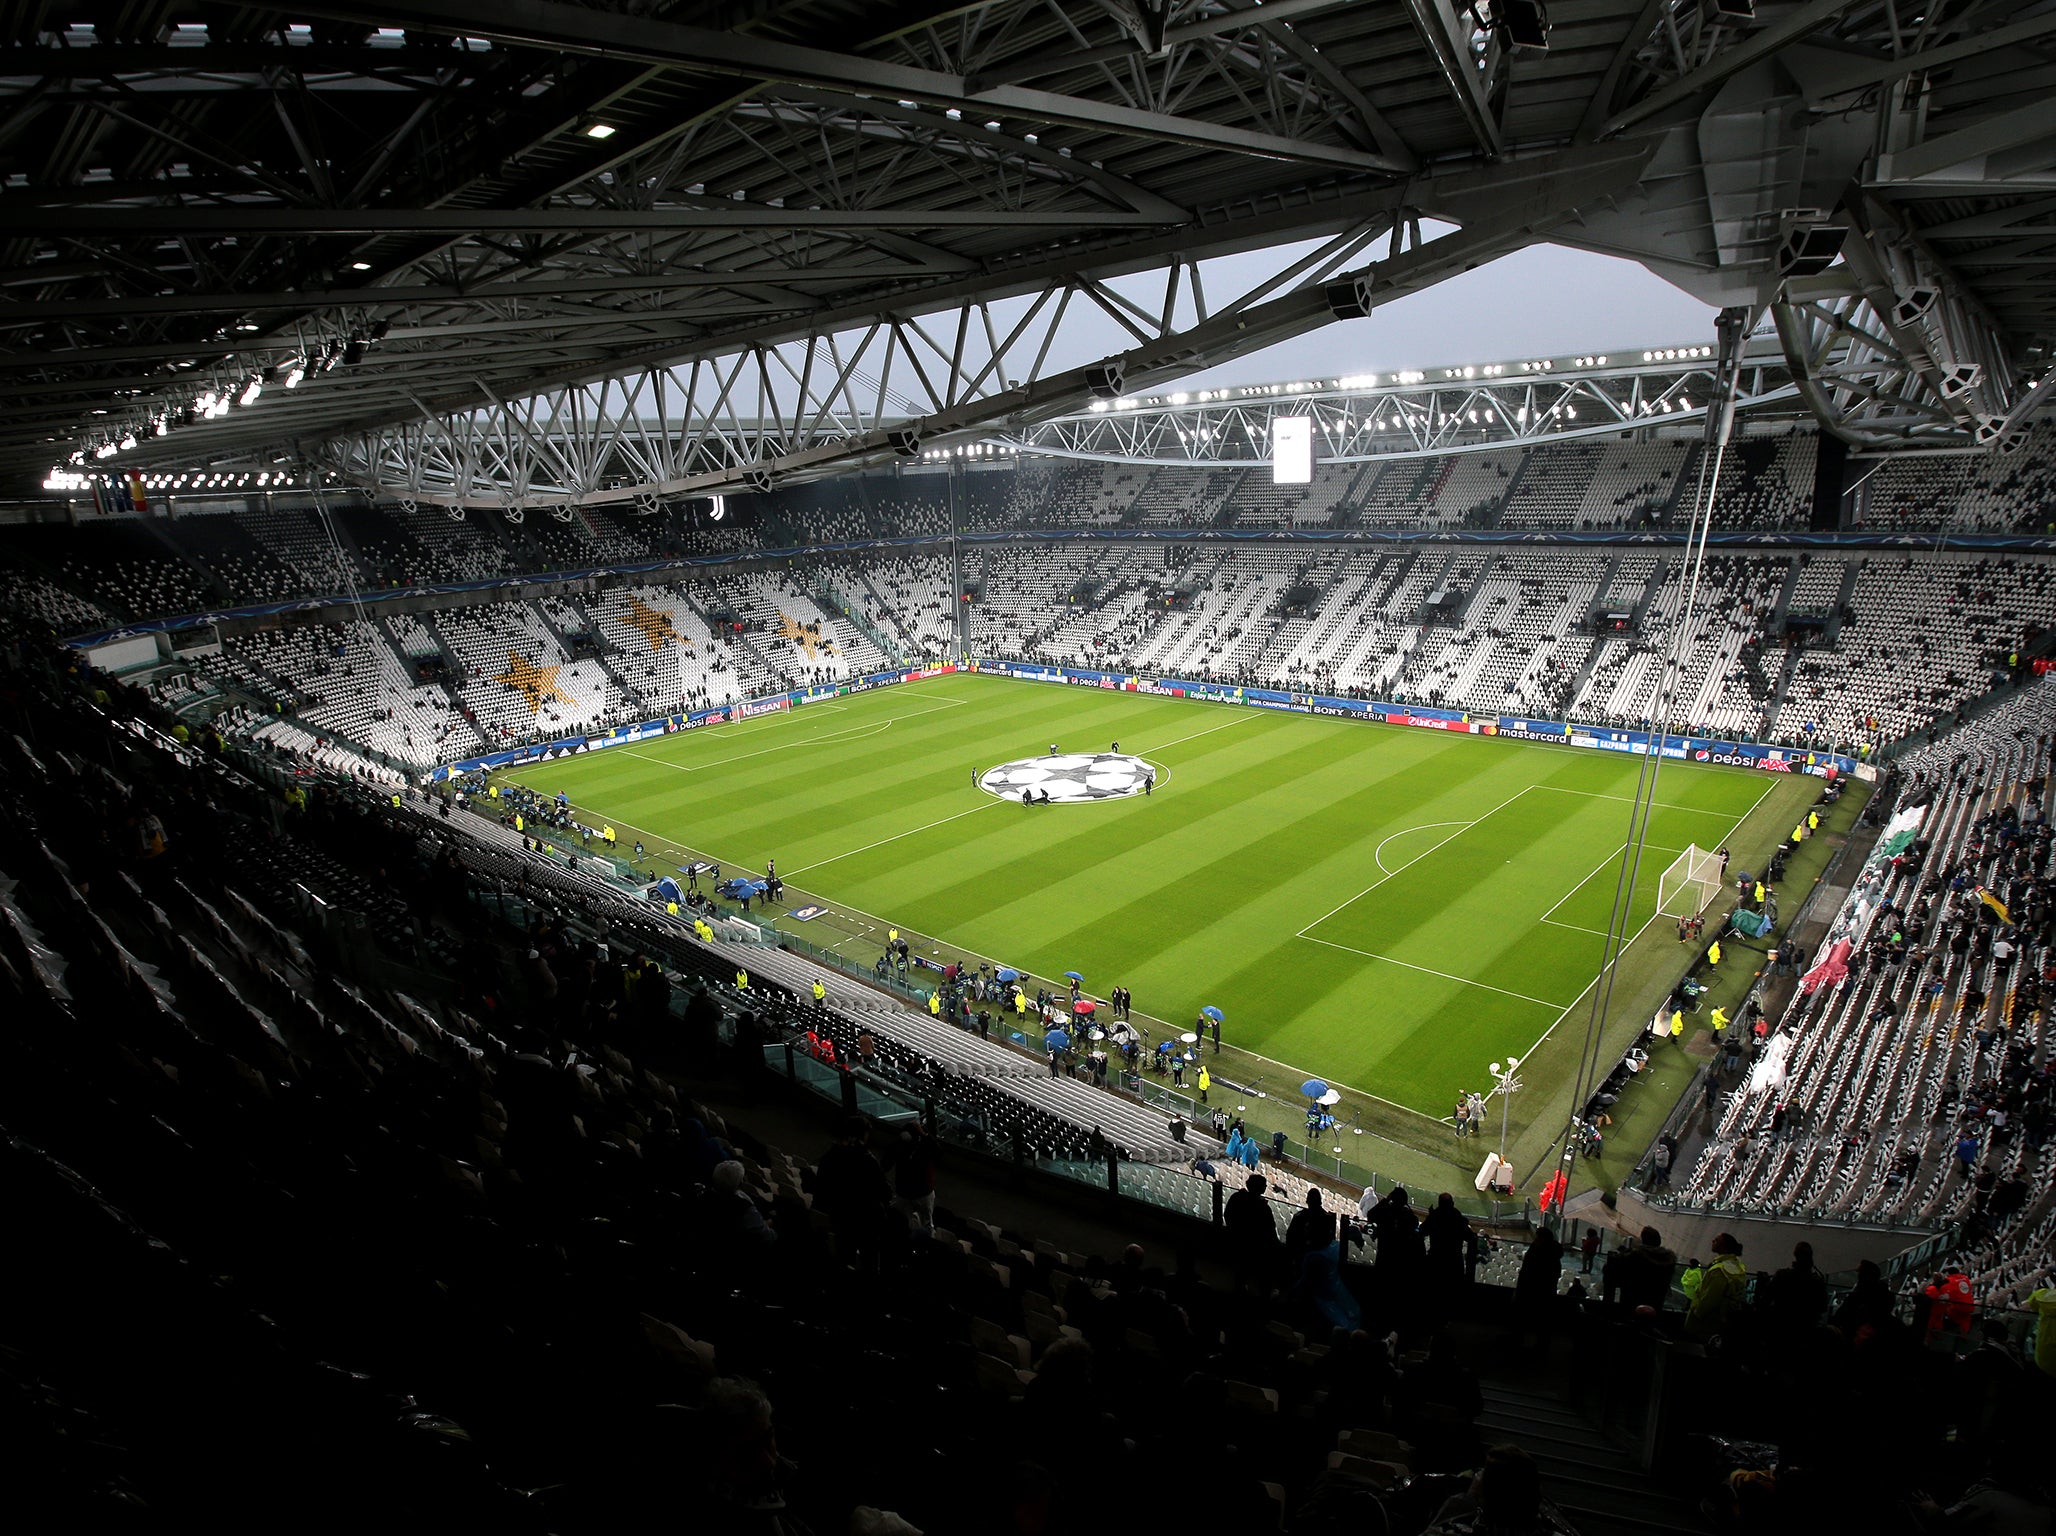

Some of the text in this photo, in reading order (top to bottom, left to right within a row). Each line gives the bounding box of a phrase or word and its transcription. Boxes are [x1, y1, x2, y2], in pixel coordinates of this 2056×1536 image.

[978, 665, 1012, 676] mastercard
[850, 677, 900, 693] SONY XPERIA
[1079, 678, 1099, 687] pepsi
[1136, 684, 1173, 696] NISSAN
[1190, 691, 1206, 701] Enjoy
[801, 692, 834, 704] Heineken
[742, 701, 781, 717] NISSAN
[1263, 701, 1290, 709] CHAMPIONS
[1313, 706, 1384, 721] SONY XPERIA
[679, 719, 704, 731] pepsi
[1417, 718, 1448, 730] UniCredit
[1499, 728, 1567, 744] mastercard
[1599, 740, 1630, 752] GAZPROM
[1712, 754, 1755, 767] pepsi
[1756, 758, 1793, 772] MAX
